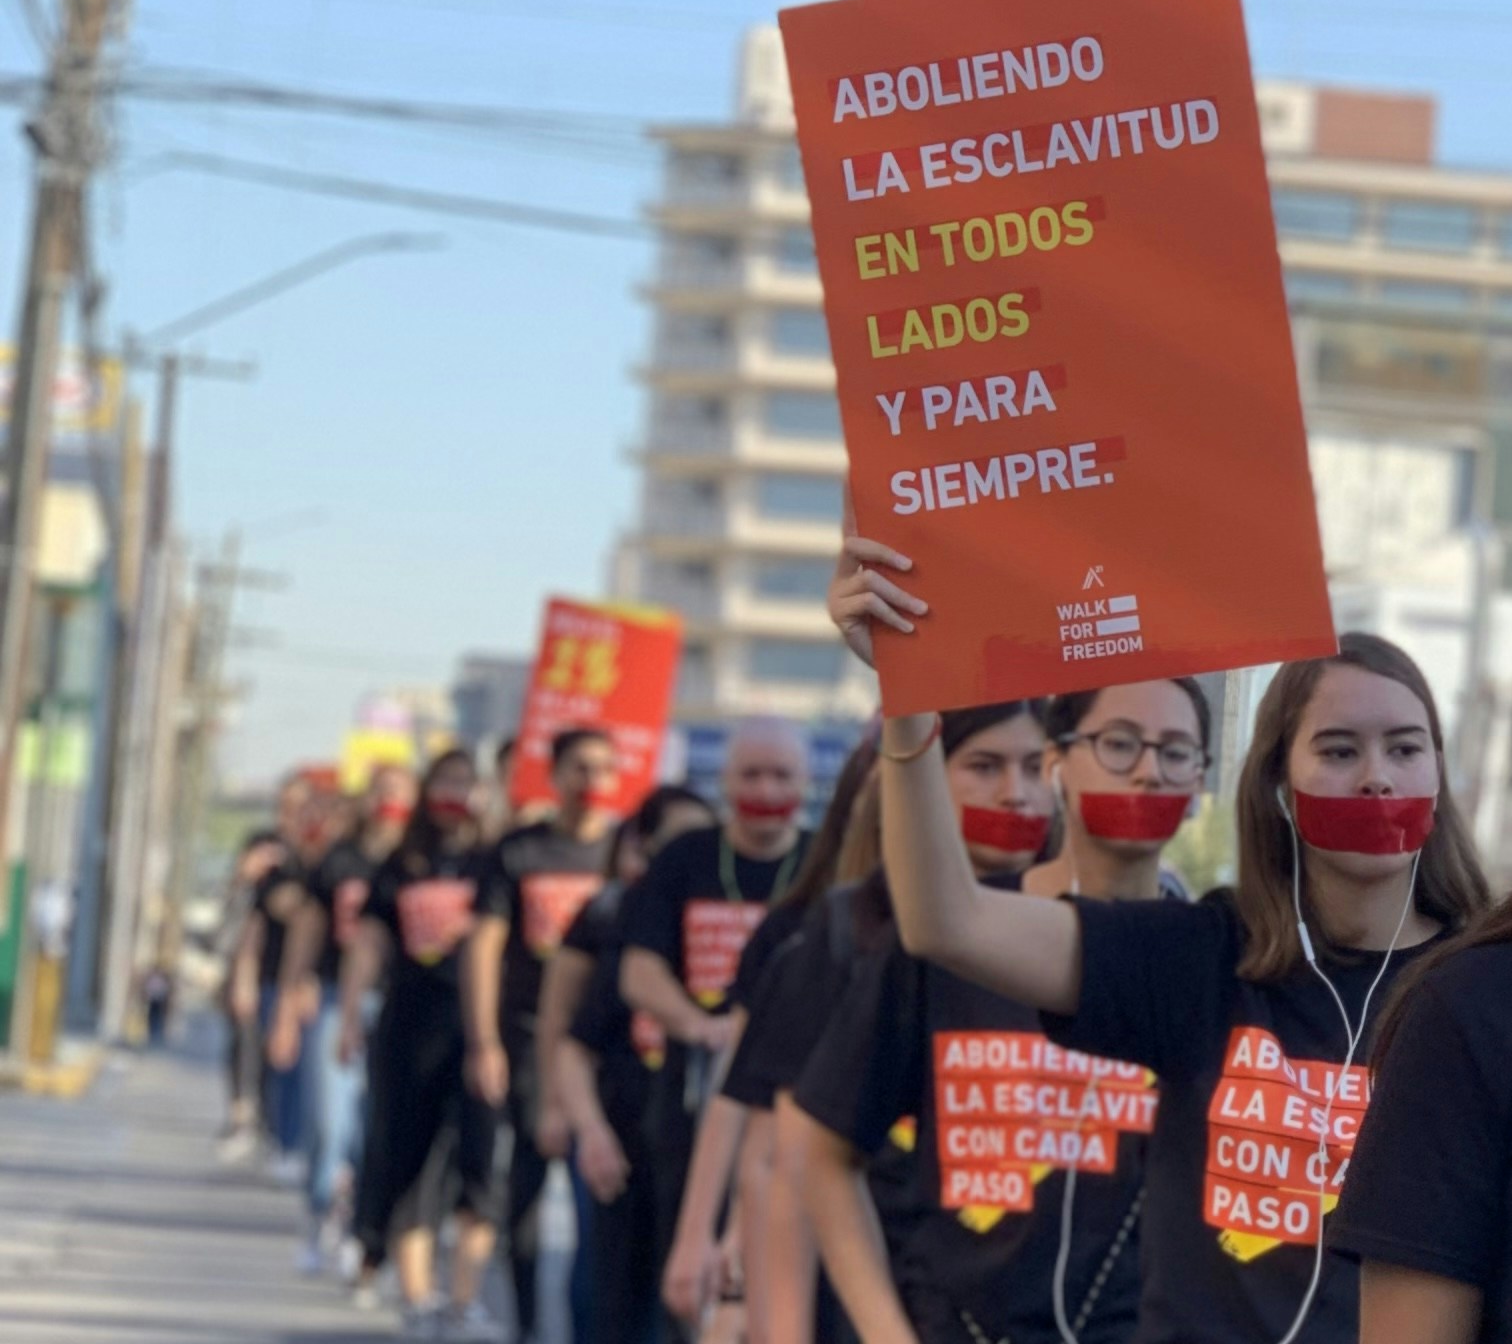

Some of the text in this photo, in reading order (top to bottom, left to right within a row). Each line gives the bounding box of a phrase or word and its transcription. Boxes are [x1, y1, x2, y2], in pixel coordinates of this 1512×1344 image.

[833, 37, 1104, 123] ABOLIENDO
[842, 99, 1219, 201] LA ESCLAVITUD
[855, 201, 1094, 280] EN TODOS
[867, 293, 1030, 358] LADOS
[876, 370, 1056, 435] Y PARA
[890, 442, 1114, 515] SIEMPRE.
[1056, 599, 1107, 621] WALK
[1060, 622, 1094, 641] FOR
[1063, 635, 1144, 662] FREEDOM
[945, 1083, 986, 1113] LA
[1220, 1087, 1266, 1122] LA
[947, 1127, 1106, 1164] CON CADA
[1216, 1135, 1290, 1179] CON
[951, 1170, 1024, 1203] PASO
[1212, 1185, 1310, 1235] PASO
